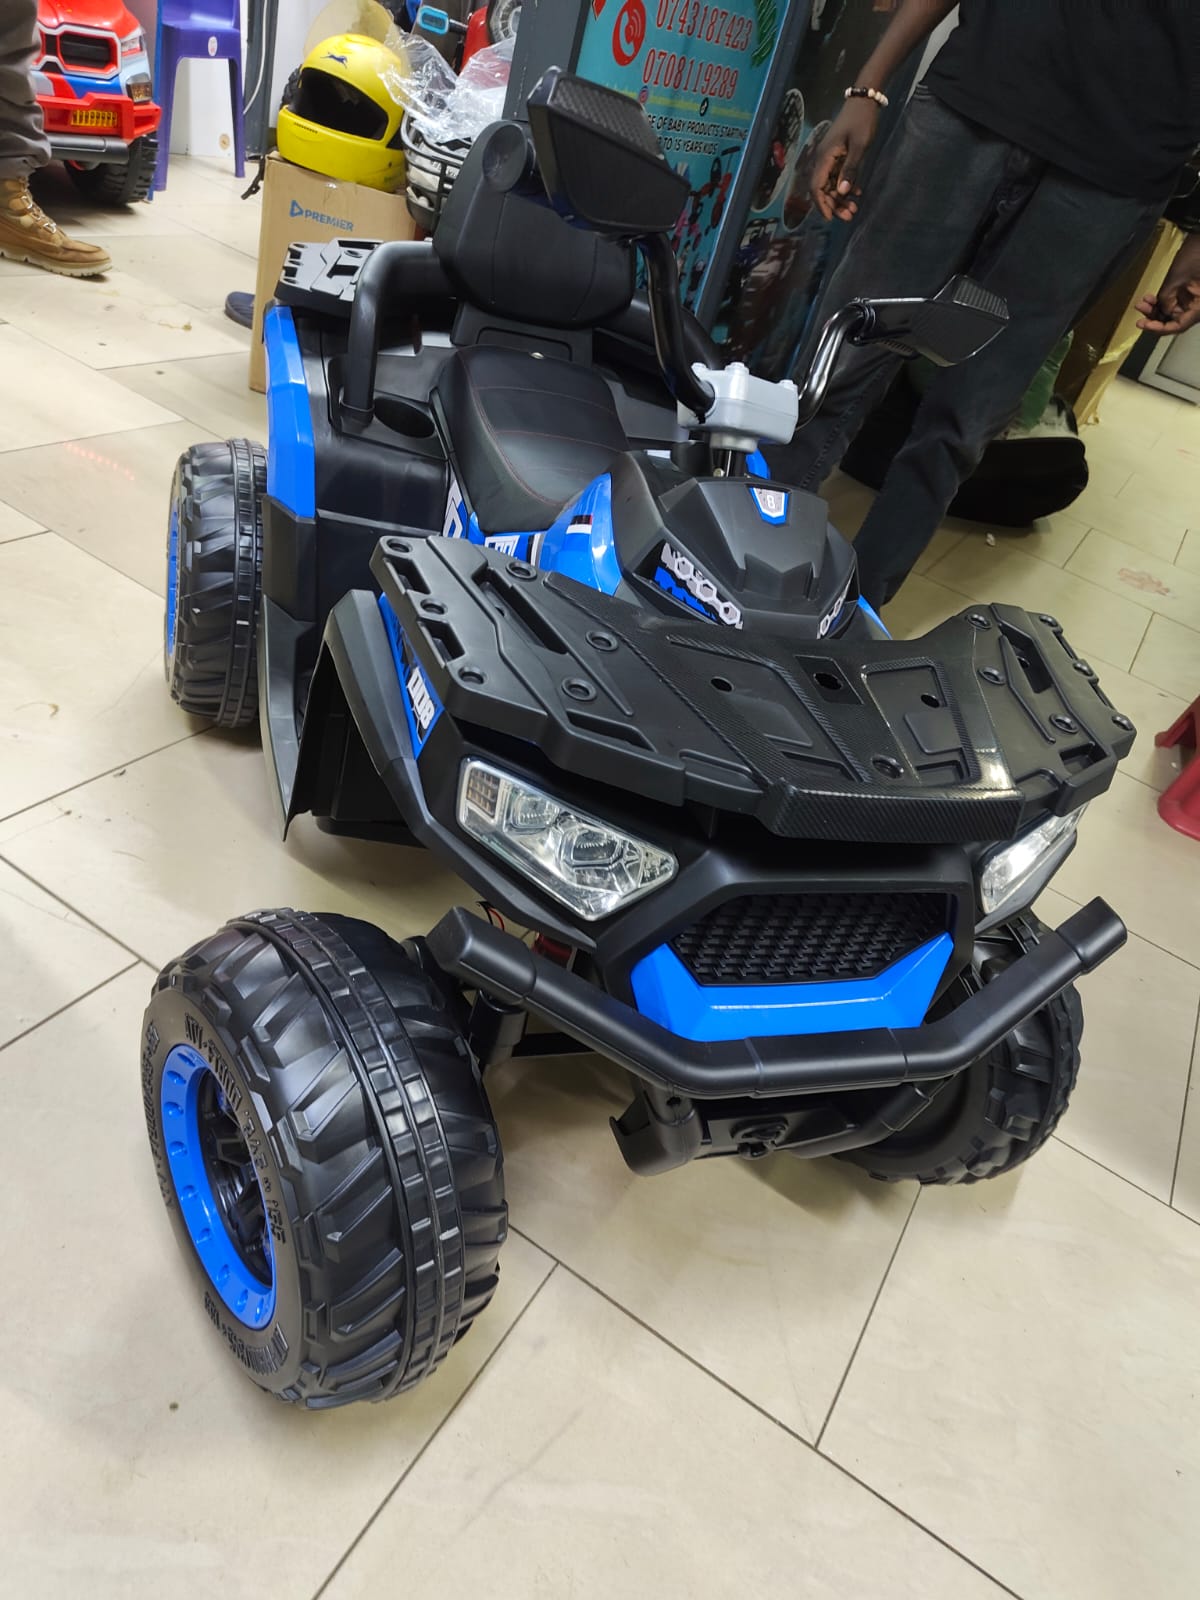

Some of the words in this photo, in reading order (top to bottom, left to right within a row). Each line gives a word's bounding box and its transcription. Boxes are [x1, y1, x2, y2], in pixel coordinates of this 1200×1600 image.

[656, 0, 753, 51] 0743187423
[642, 48, 739, 99] 0708119289
[656, 116, 668, 130] OF
[667, 118, 685, 132] BABY
[687, 120, 720, 137] PRODUCTS
[720, 125, 748, 141] STARTING
[664, 136, 673, 151] TO
[684, 140, 703, 154] YEARS
[304, 208, 354, 232] PREMIER
